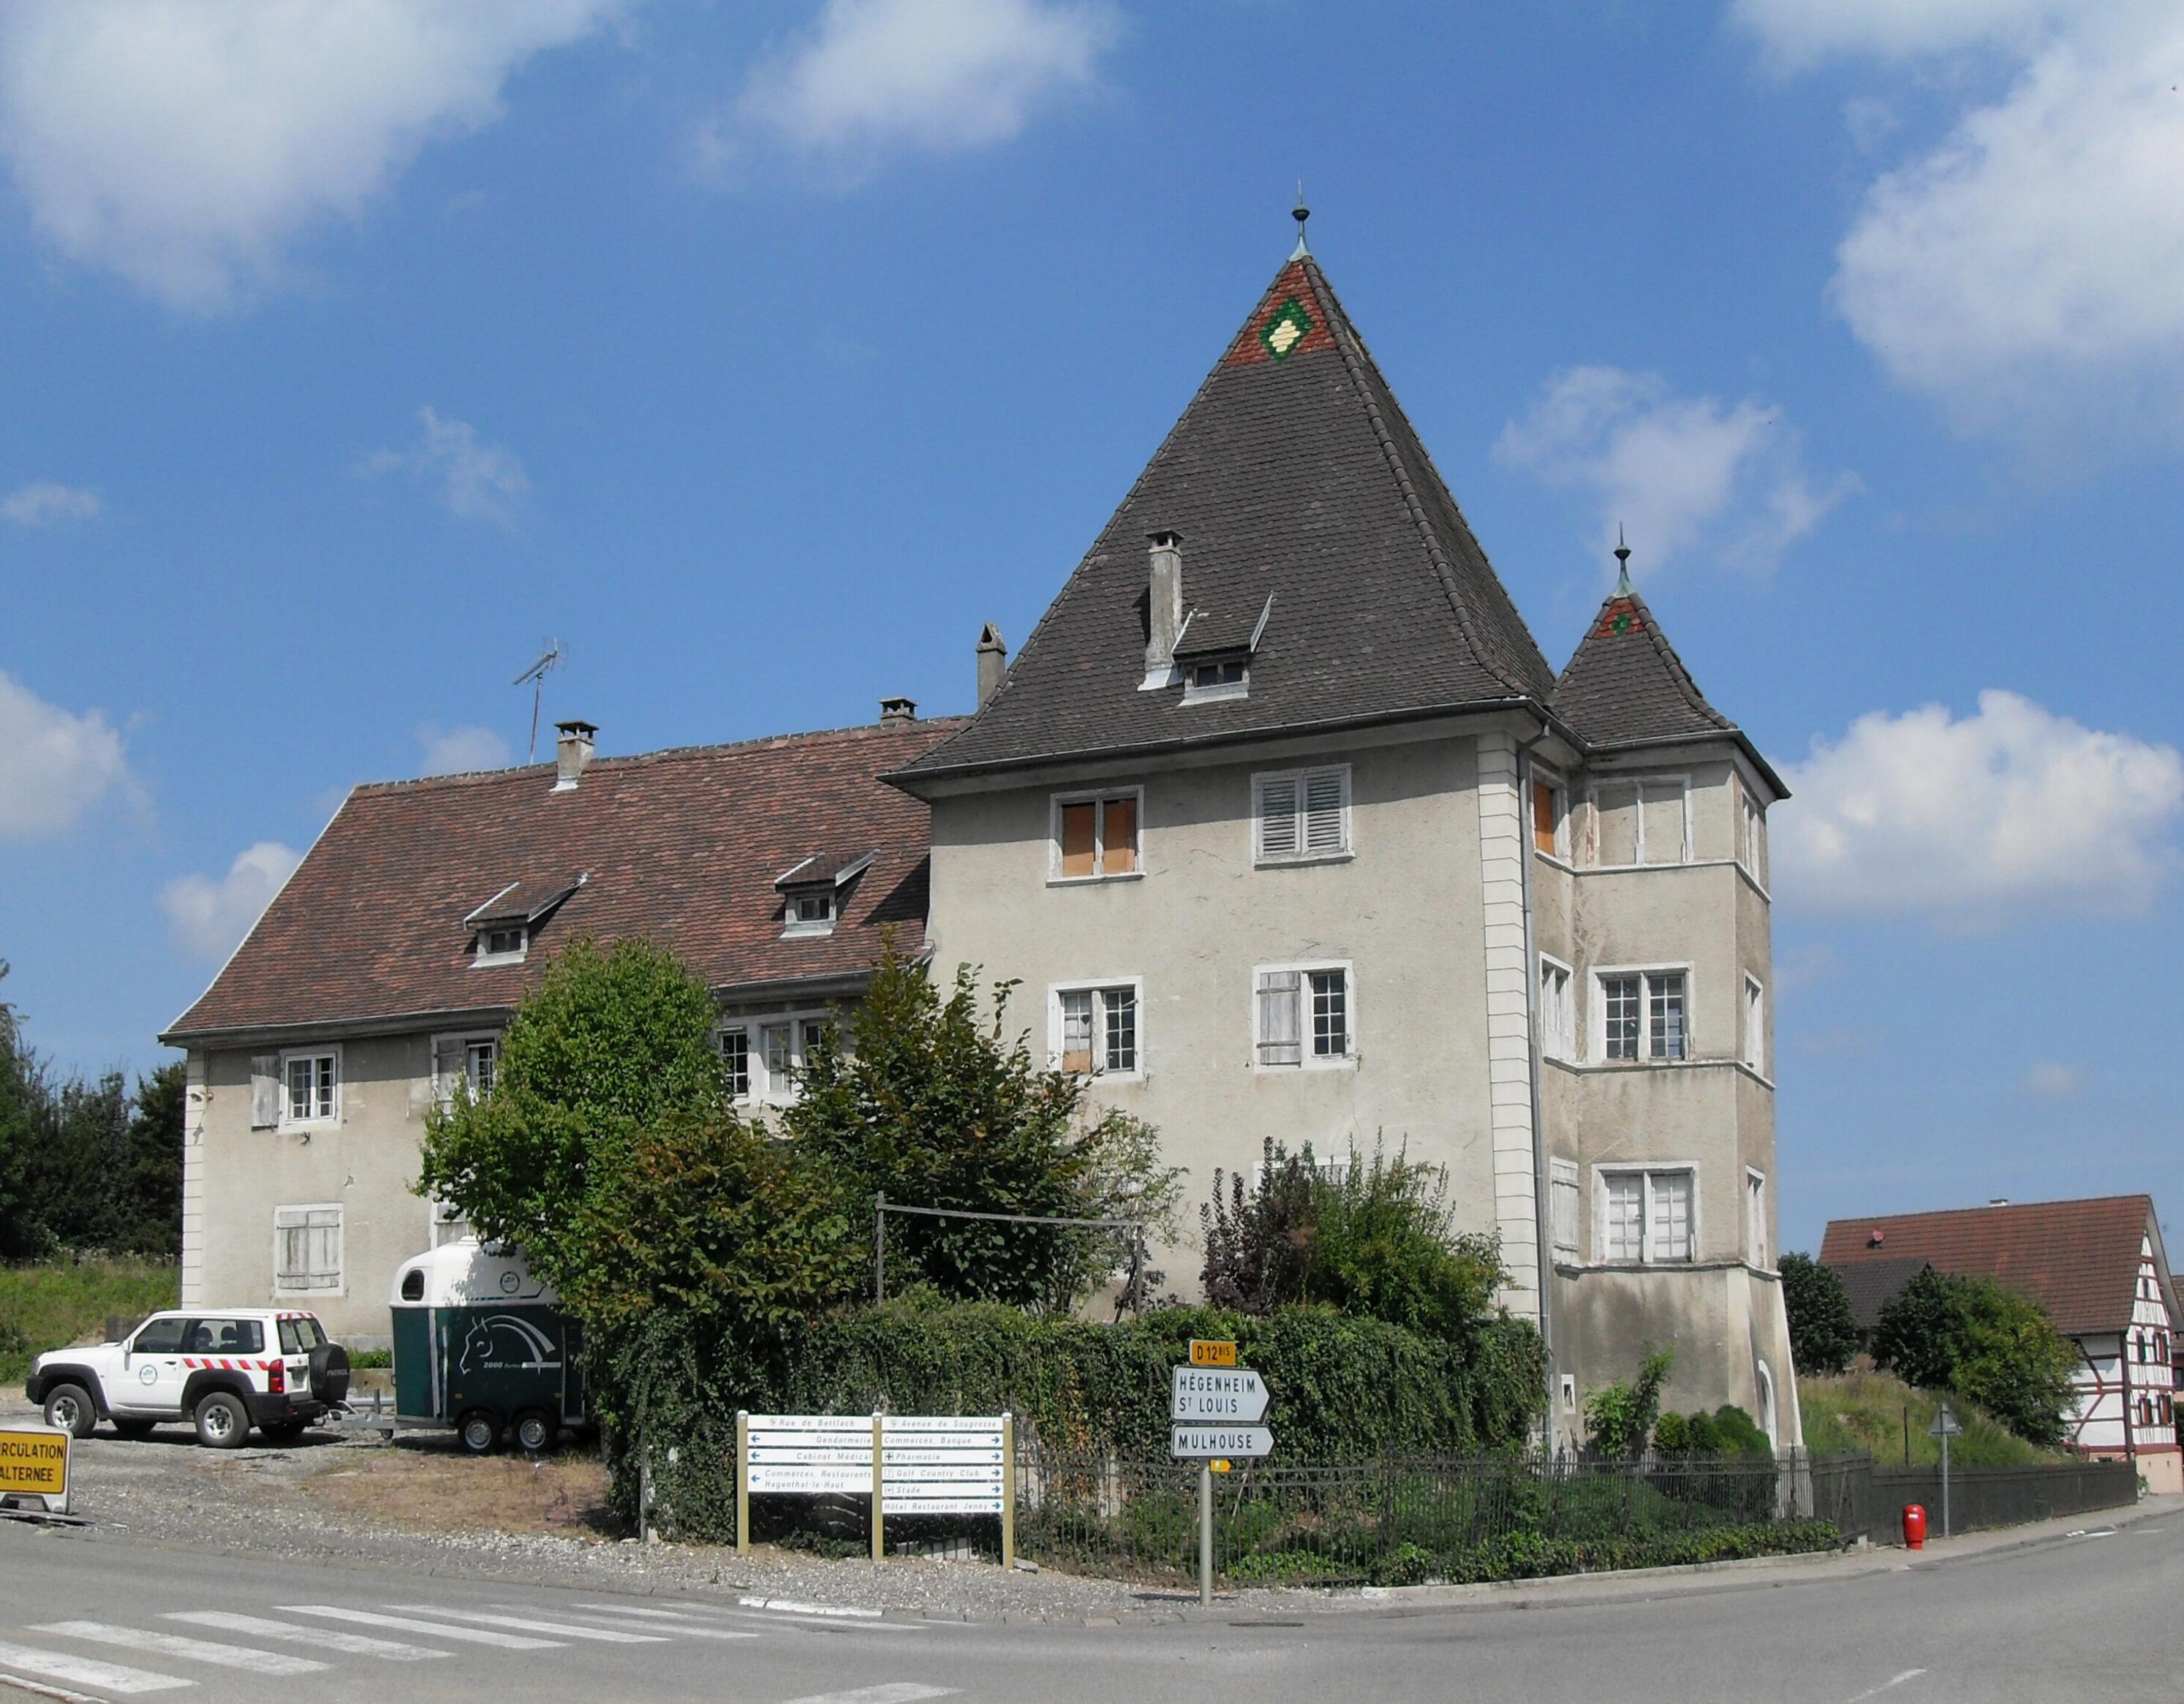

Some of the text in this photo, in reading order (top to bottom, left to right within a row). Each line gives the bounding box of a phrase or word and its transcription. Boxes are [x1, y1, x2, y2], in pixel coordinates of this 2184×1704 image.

[1197, 1345, 1204, 1360] D
[1179, 1372, 1255, 1393] HÉGENHEIM
[1199, 1398, 1237, 1413] LOUIS
[817, 1419, 855, 1427] Bettlach
[953, 1420, 997, 1428] Souprosse
[816, 1436, 872, 1444] Gendarmerie
[940, 1436, 972, 1445] Banque
[1179, 1434, 1252, 1450] MULHOUSE
[0, 1442, 64, 1459] RCULATION
[836, 1452, 872, 1460] Médical
[896, 1453, 940, 1461] Pharmacie
[821, 1470, 872, 1478] Restaurants
[921, 1469, 953, 1478] Country
[884, 1502, 907, 1510] Hôtel
[964, 1503, 988, 1512] Jenny
